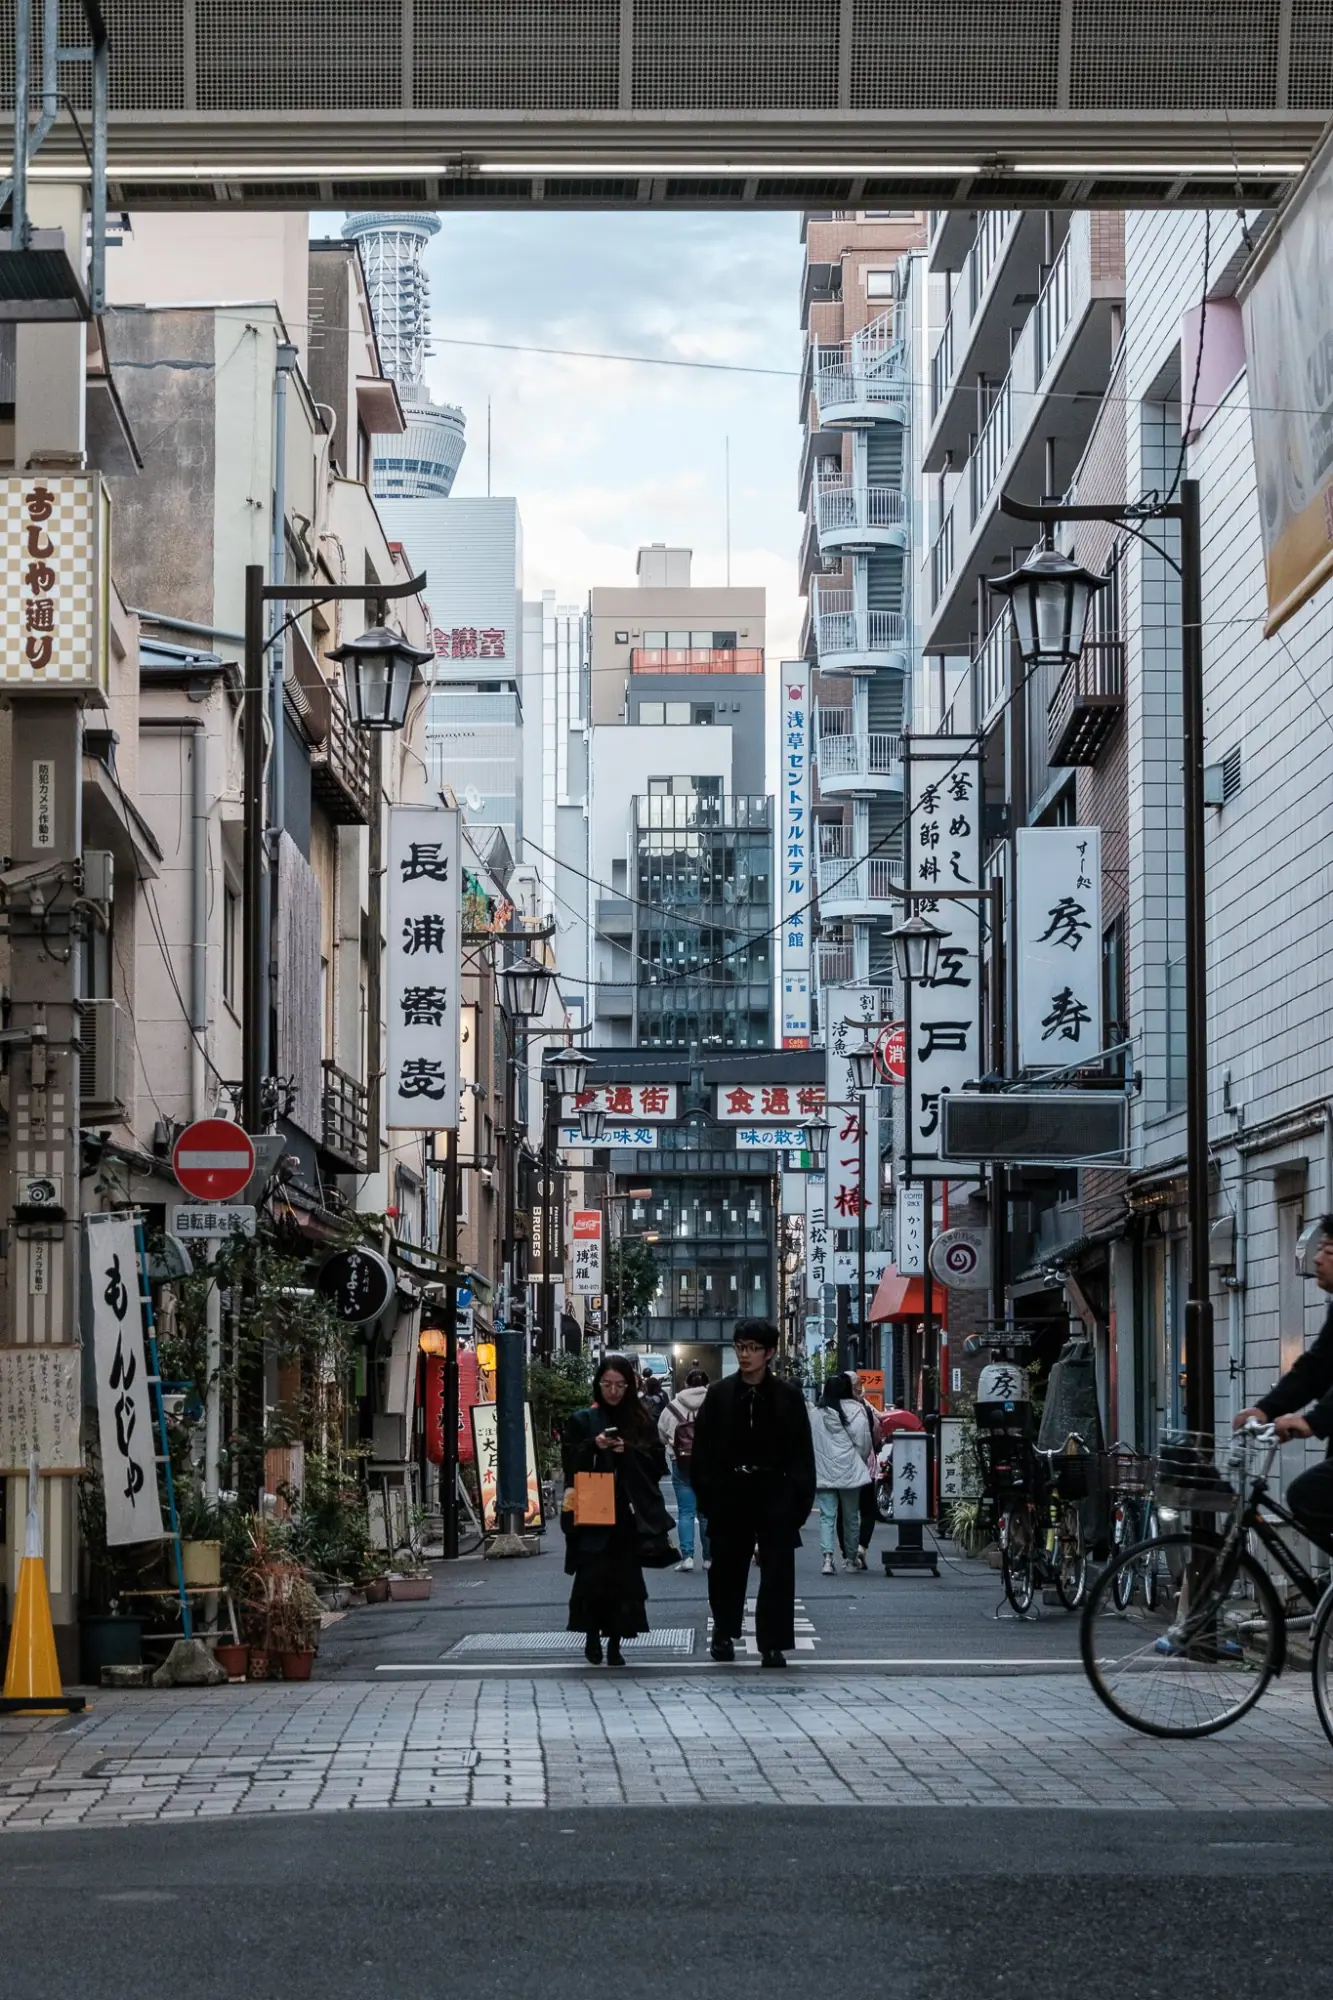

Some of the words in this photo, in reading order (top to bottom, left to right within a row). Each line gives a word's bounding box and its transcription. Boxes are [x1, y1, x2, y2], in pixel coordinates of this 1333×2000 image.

[25, 486, 56, 669] すしや通り
[427, 627, 506, 659] 会議室
[38, 763, 50, 845] 防犯カメラ作動中
[787, 711, 805, 893] 浅草セントラルホテル
[947, 772, 976, 884] 釜めし
[1076, 841, 1092, 889] すし処
[788, 914, 804, 947] 本館
[398, 842, 449, 1101] 長浦蕎麦
[1029, 896, 1092, 1043] 房寿
[832, 1021, 848, 1055] 活魚
[725, 1086, 826, 1115] 食通街
[563, 1127, 653, 1144] 下の味処
[177, 1213, 250, 1232] 自転車を除く
[532, 1206, 542, 1258] BRUGES
[809, 1208, 828, 1284] 三松寿司
[860, 1375, 882, 1385] ランチ
[899, 1462, 918, 1506] 房寿
